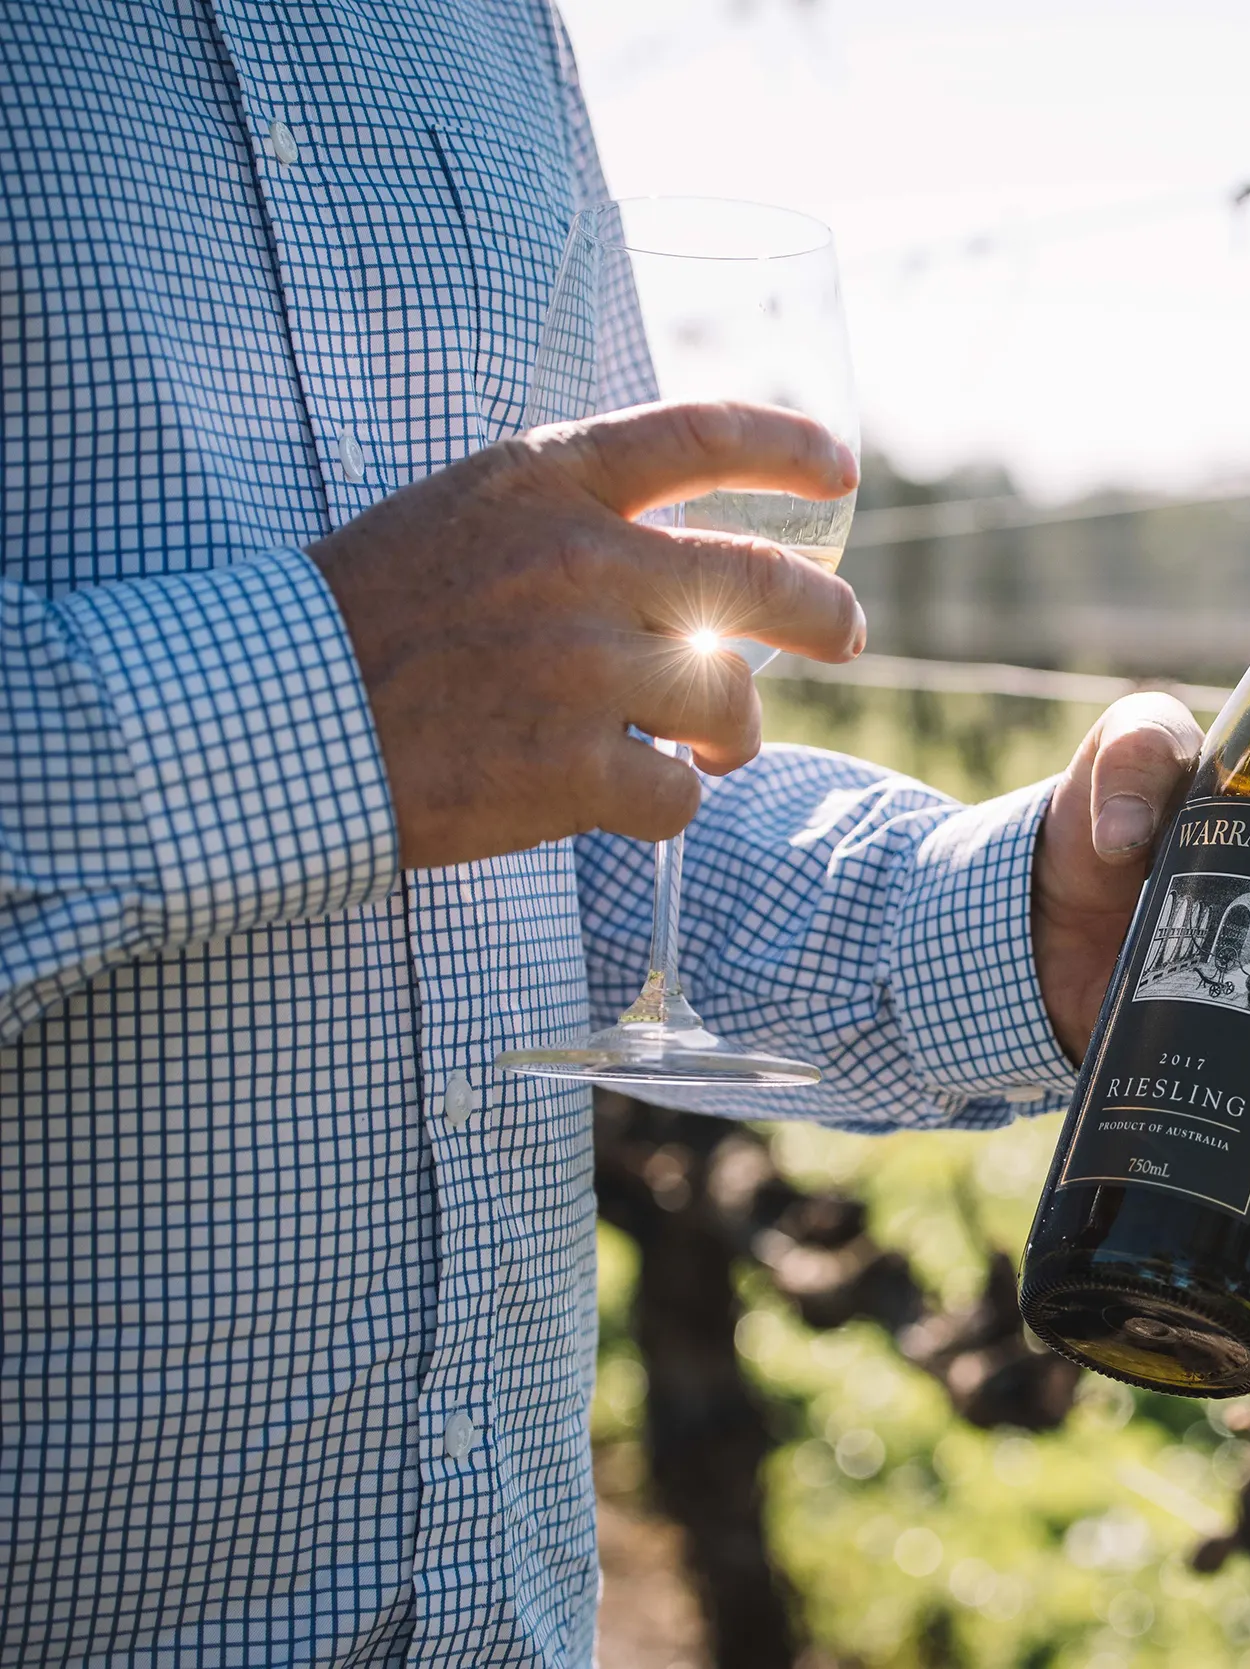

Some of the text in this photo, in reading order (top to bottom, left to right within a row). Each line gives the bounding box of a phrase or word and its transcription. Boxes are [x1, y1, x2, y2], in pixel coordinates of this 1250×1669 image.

[1159, 1052, 1206, 1070] 2017
[1107, 1077, 1246, 1117] RIESLING
[1098, 1120, 1229, 1151] PRODUCT OF AUSTRALIA
[1128, 1157, 1170, 1178] 750mL
